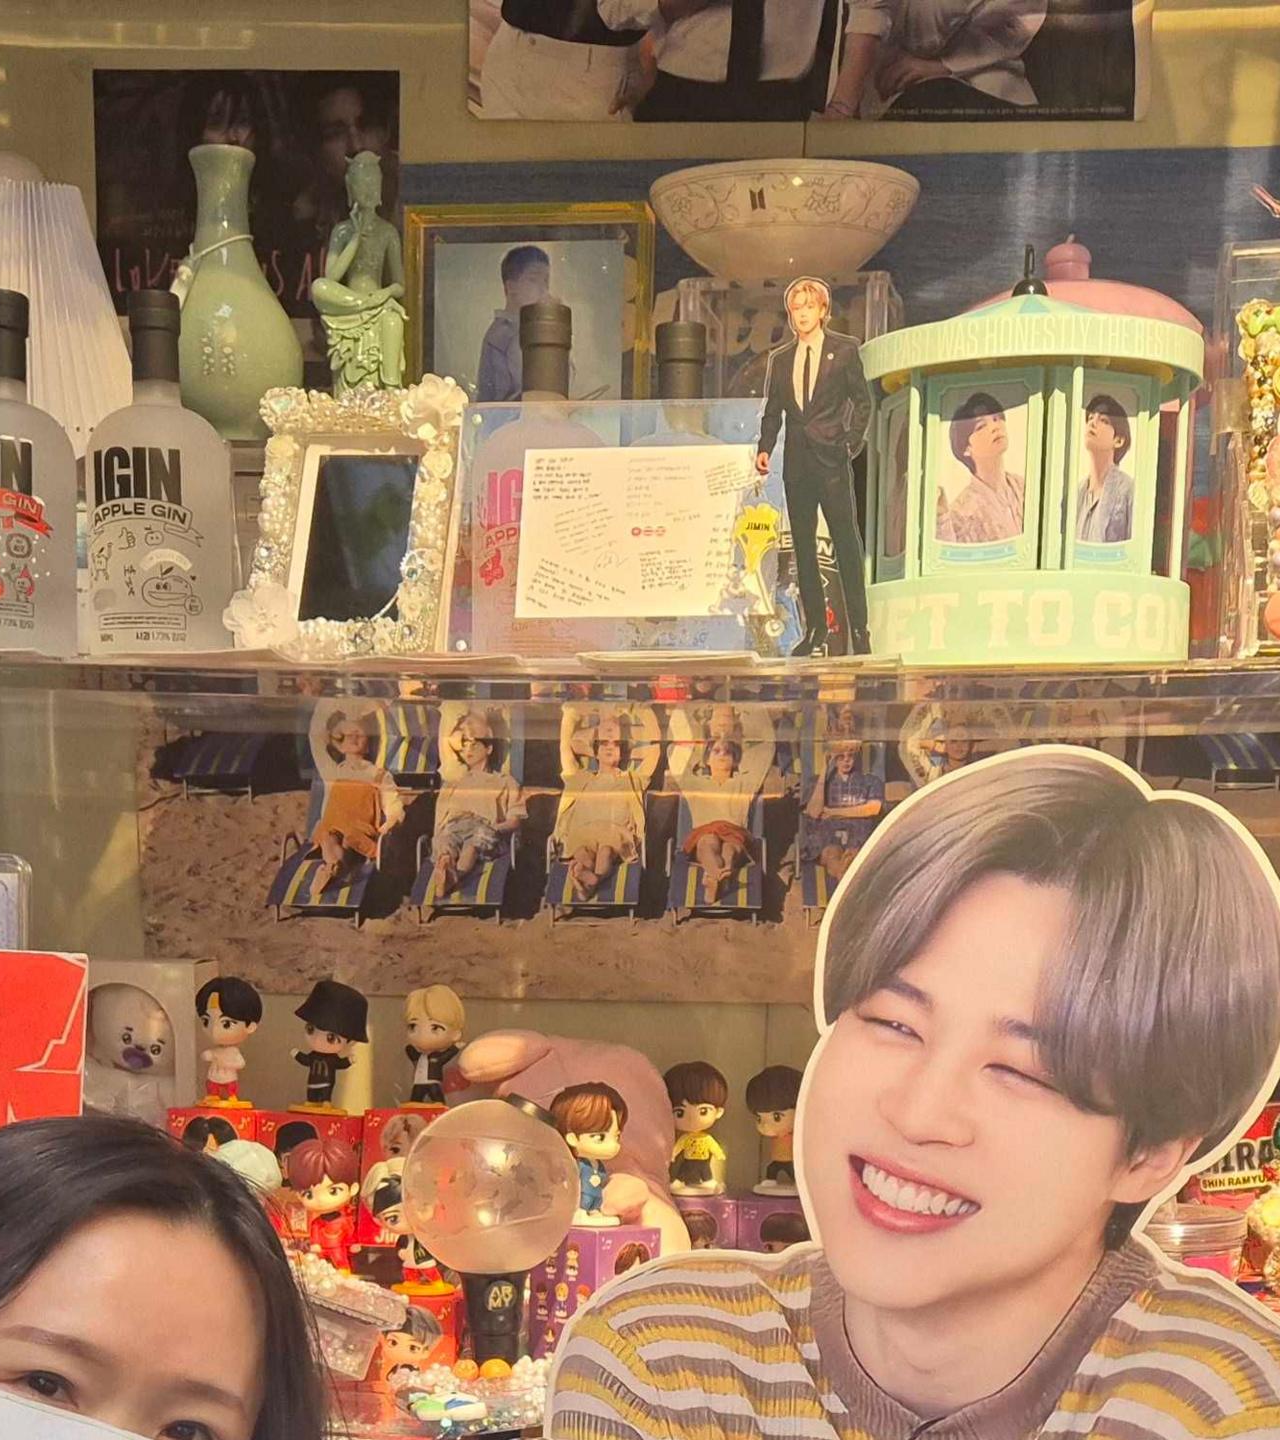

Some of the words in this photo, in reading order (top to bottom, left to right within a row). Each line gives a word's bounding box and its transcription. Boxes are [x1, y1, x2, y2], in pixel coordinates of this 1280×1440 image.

[939, 323, 982, 357] WAS
[985, 315, 1094, 355] HONESTLY
[94, 447, 182, 507] IGIN
[2, 492, 39, 514] GIN
[94, 502, 146, 526] APPLE
[151, 504, 188, 525] GIN
[745, 522, 771, 532] JIMIN
[978, 588, 1074, 649] TO
[1204, 1139, 1276, 1176] IRA
[1202, 1177, 1226, 1189] SHIN
